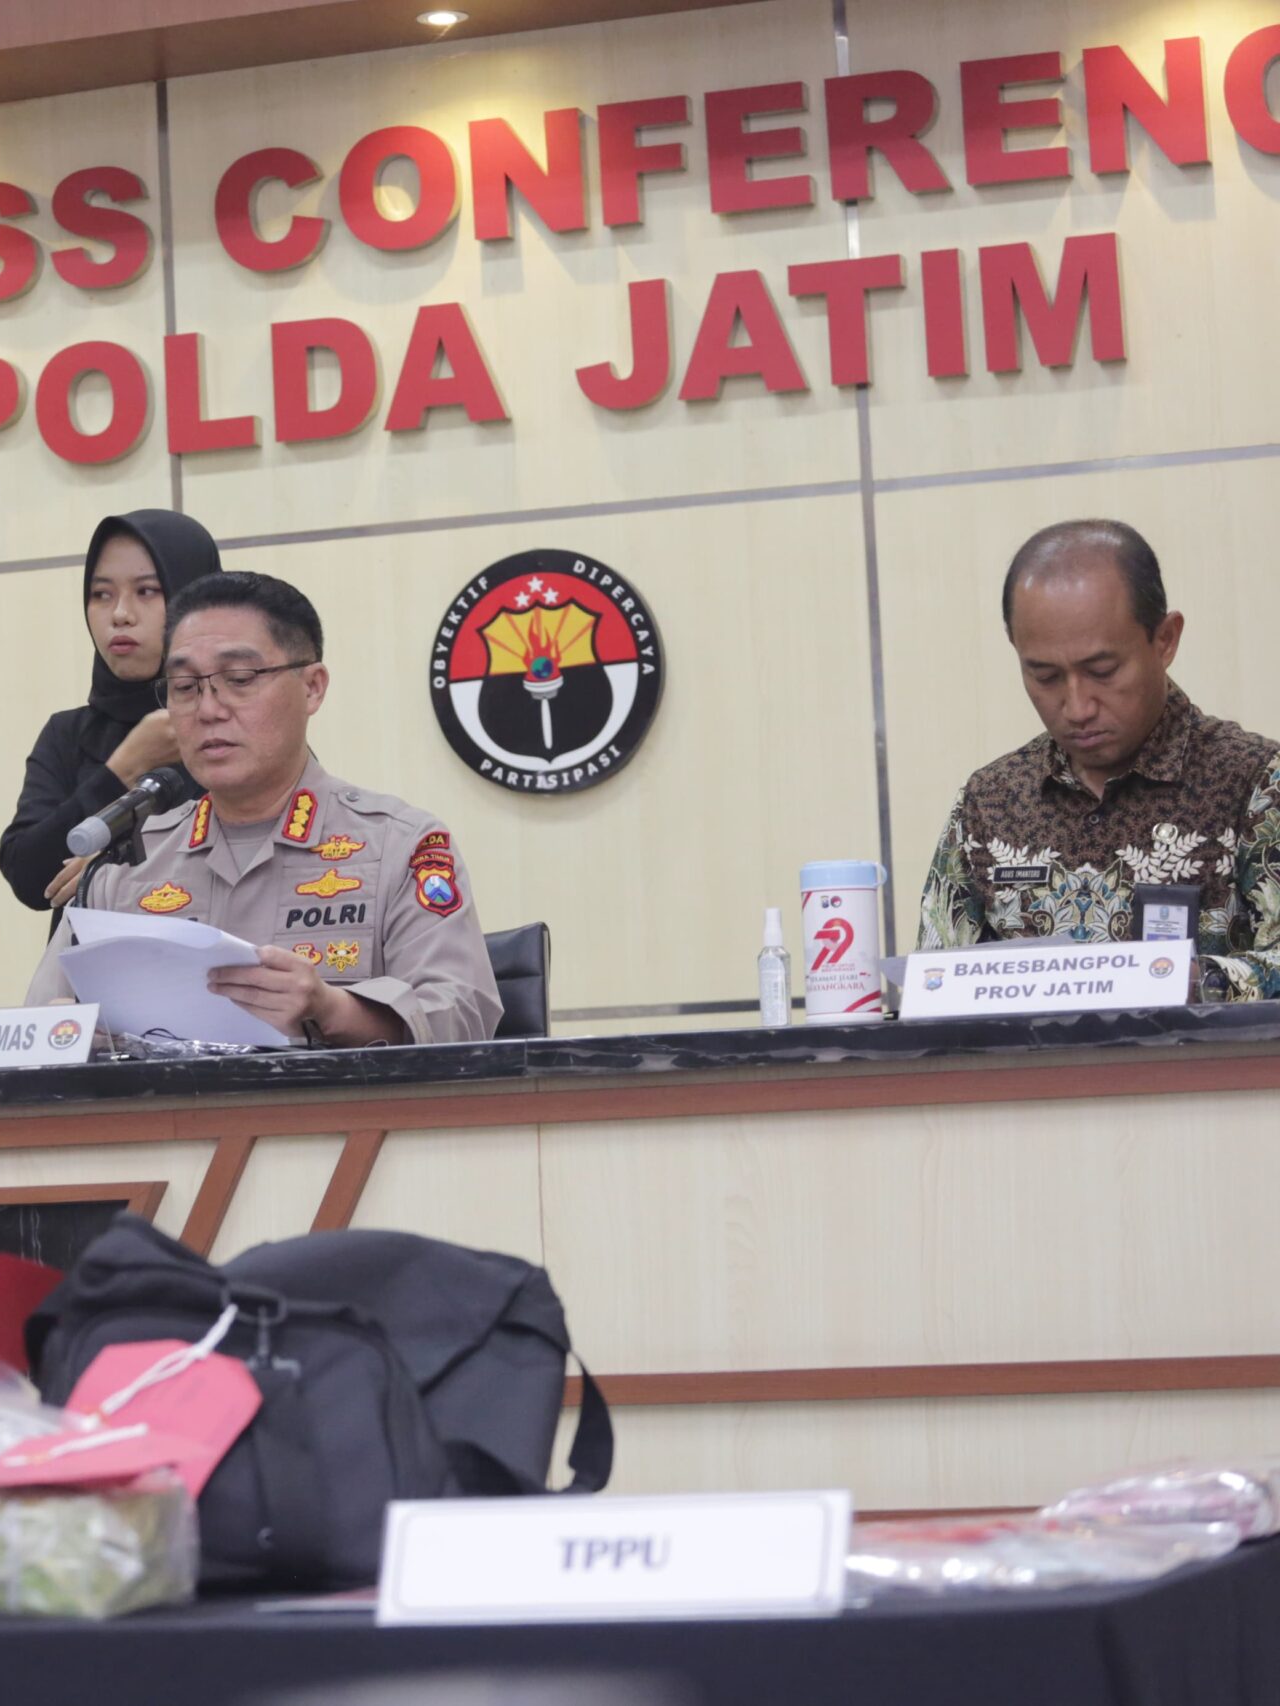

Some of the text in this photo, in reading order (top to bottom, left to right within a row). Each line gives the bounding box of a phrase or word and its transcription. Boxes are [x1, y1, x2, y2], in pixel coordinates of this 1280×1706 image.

[575, 232, 1125, 410] JATIM
[433, 576, 489, 688] OBYEKTIF
[573, 560, 655, 675] DIPERCAYA
[286, 902, 366, 928] POLRI
[953, 954, 1140, 977] BAKESBANGPOL
[974, 980, 1113, 1000] PROV JATIM
[558, 1533, 672, 1571] TPPU
